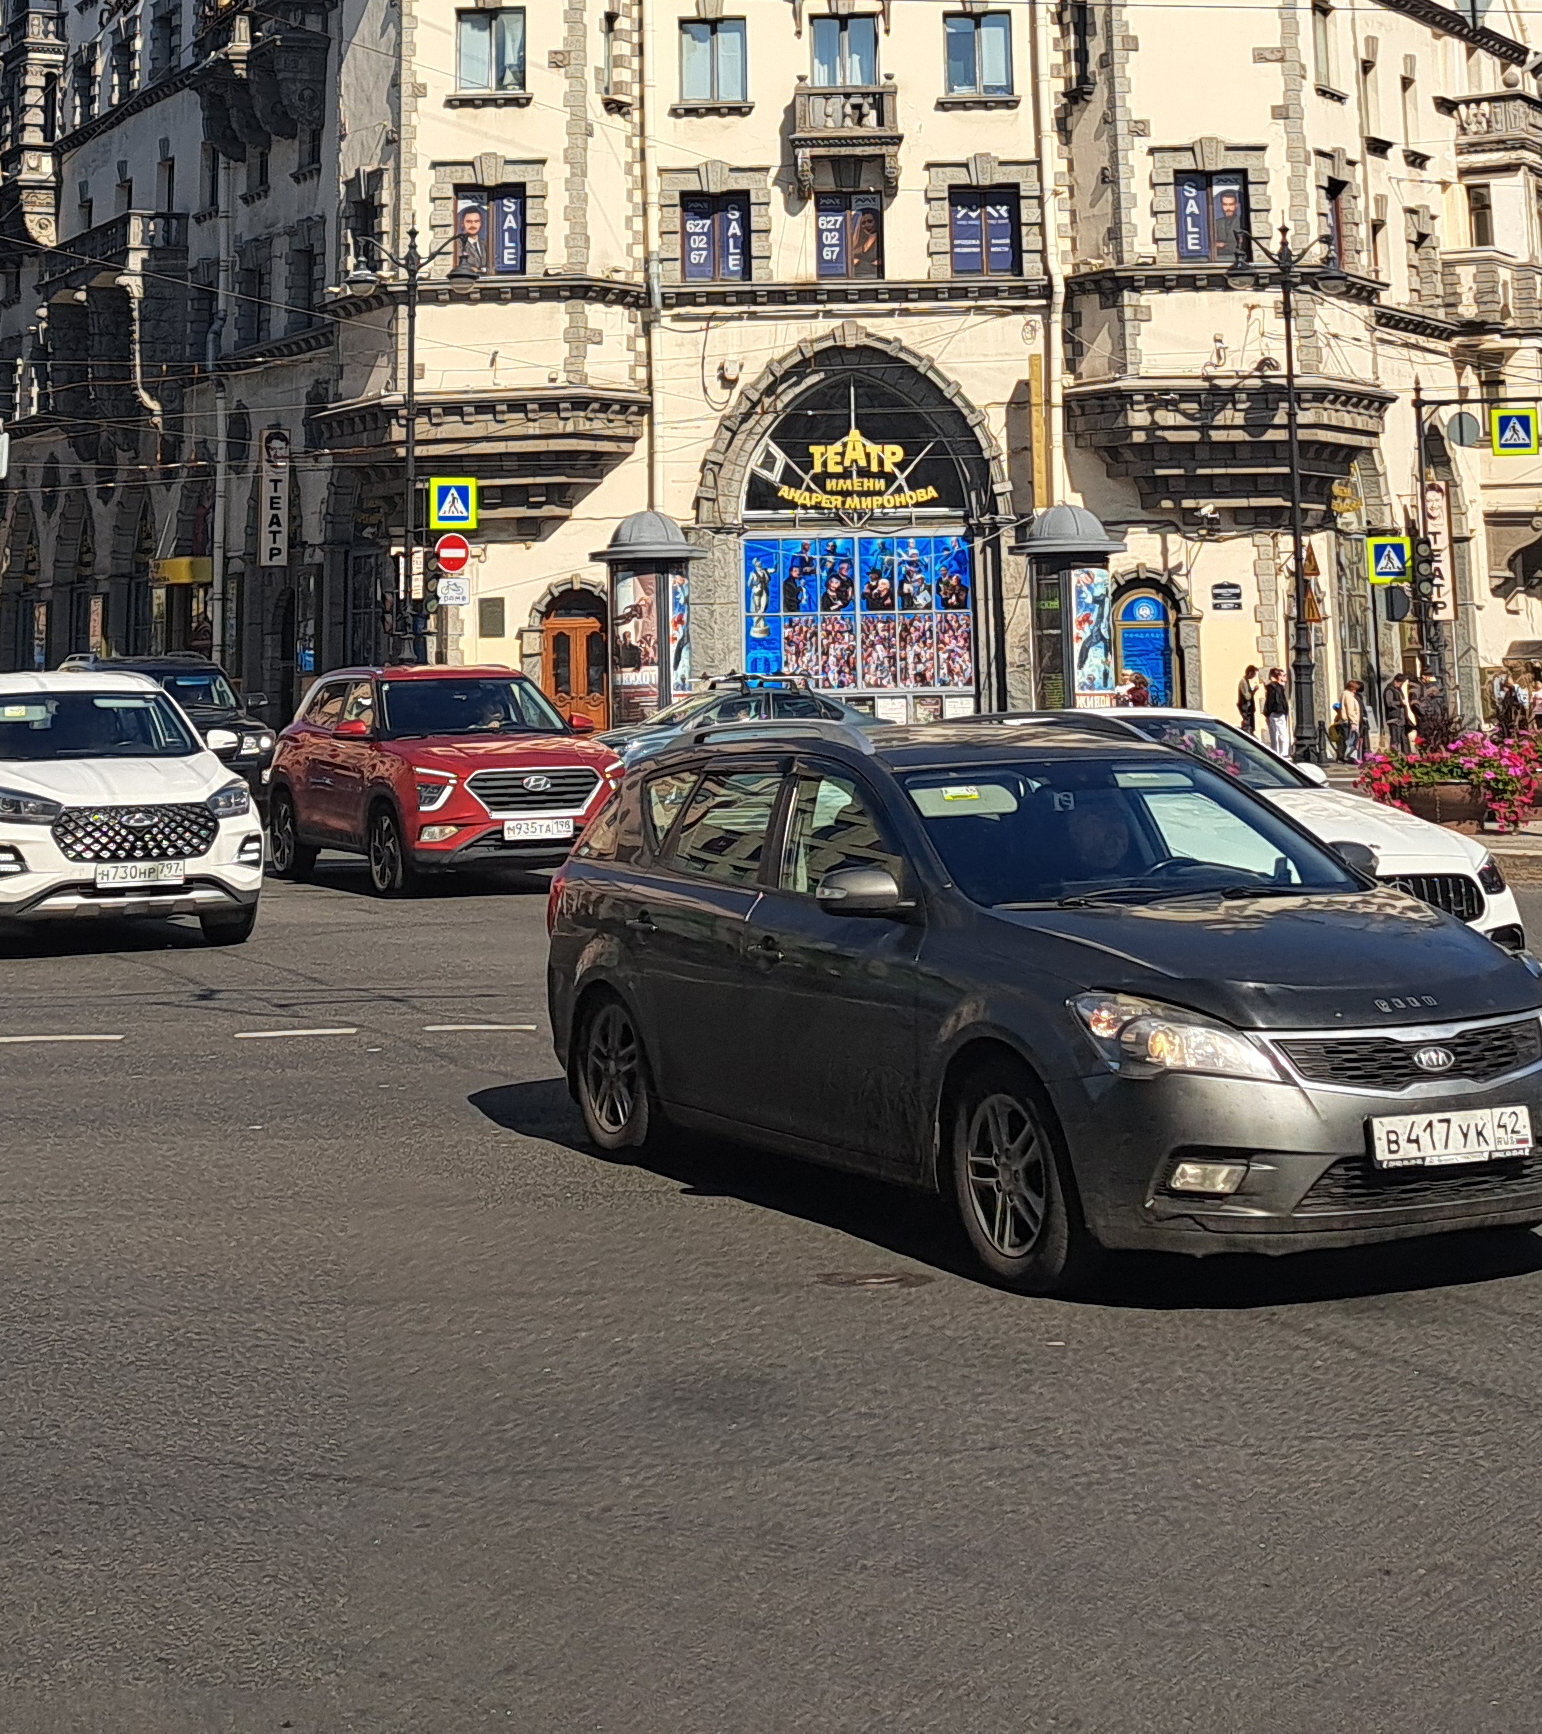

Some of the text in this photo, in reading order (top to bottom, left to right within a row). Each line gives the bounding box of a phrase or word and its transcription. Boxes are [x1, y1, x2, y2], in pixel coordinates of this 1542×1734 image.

[818, 216, 843, 229] 627
[1183, 181, 1202, 250] SALE
[502, 197, 518, 265] SALE
[686, 220, 711, 233] 627
[690, 236, 708, 248] 02
[726, 204, 742, 270] SALE
[822, 232, 839, 245] 02
[690, 251, 707, 264] 67
[822, 247, 840, 261] 67
[809, 429, 905, 474] ТЕАТР
[825, 477, 886, 492] ИМЕНИ
[777, 485, 939, 510] АНДРЕЯ МИРОНОВА
[267, 478, 283, 562] ТЕАТР
[1428, 531, 1448, 616] ТЕАТР
[101, 862, 180, 881] Н730НР 797
[1419, 1051, 1450, 1066] KIA
[1385, 1110, 1522, 1155] В417УК 42
